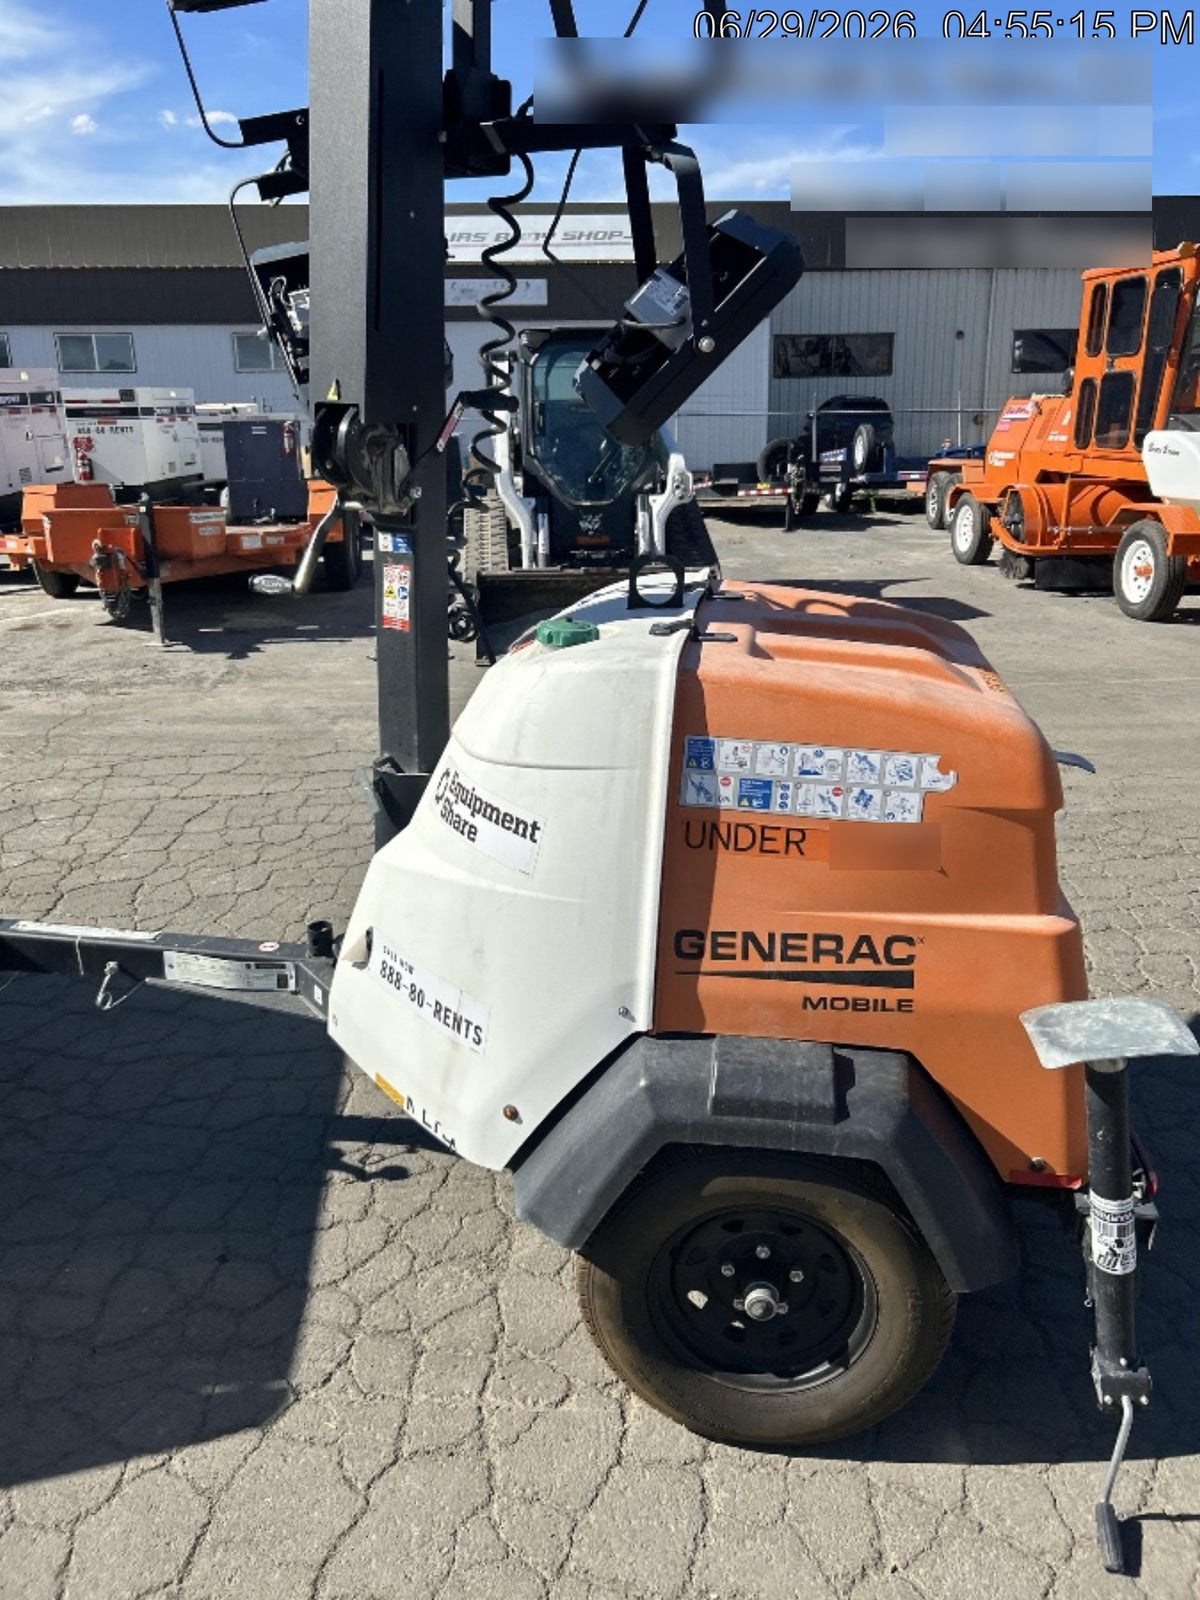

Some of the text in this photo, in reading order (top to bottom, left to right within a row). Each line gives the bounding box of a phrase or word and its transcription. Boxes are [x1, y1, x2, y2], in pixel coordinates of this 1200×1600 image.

[440, 796, 478, 843] Share
[449, 770, 541, 844] Equipment
[683, 821, 808, 856] UNDER
[674, 929, 917, 966] GENERAC
[380, 959, 483, 1046] 888-80-RENTS
[802, 997, 915, 1013] MOBILE
